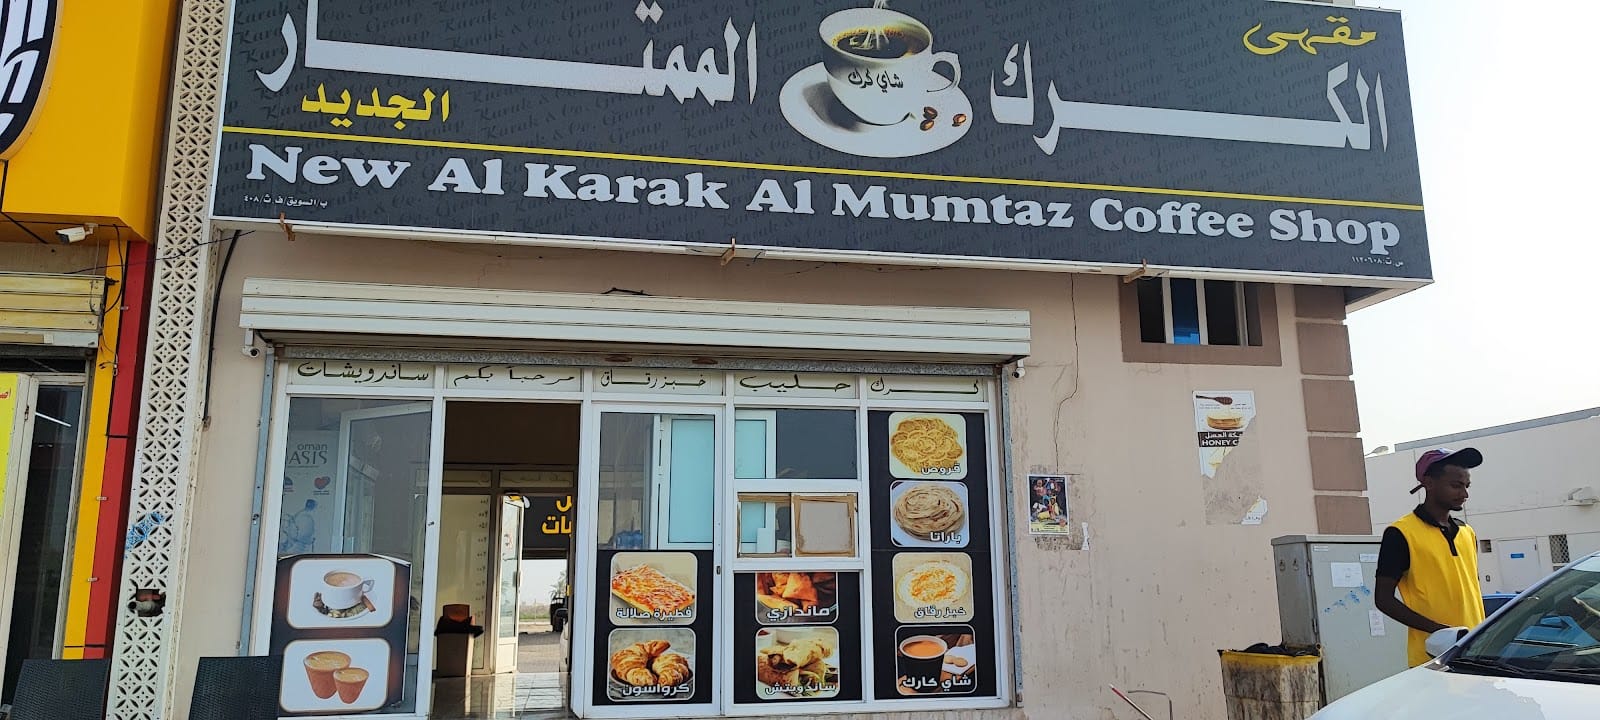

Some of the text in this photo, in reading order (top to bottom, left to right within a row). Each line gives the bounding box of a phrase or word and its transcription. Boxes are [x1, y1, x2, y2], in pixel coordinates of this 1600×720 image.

[877, 70, 904, 93] شاي
[301, 83, 450, 130] الجديد
[246, 143, 411, 189] New
[427, 157, 505, 195] Al
[523, 162, 730, 210] Karak
[745, 178, 815, 215] Al
[831, 182, 1075, 228] Mumtaz
[1089, 197, 1254, 239] Coffee
[1269, 208, 1401, 256] Shop
[739, 373, 851, 393] حليب
[297, 443, 328, 451] oman
[1201, 439, 1231, 447] HONEY
[286, 450, 328, 465] ASIS
[616, 606, 693, 622] فطيرة صلالة
[765, 605, 831, 622] ماندازي
[621, 682, 690, 697] كرواسون
[902, 674, 972, 692] شاي كارك
